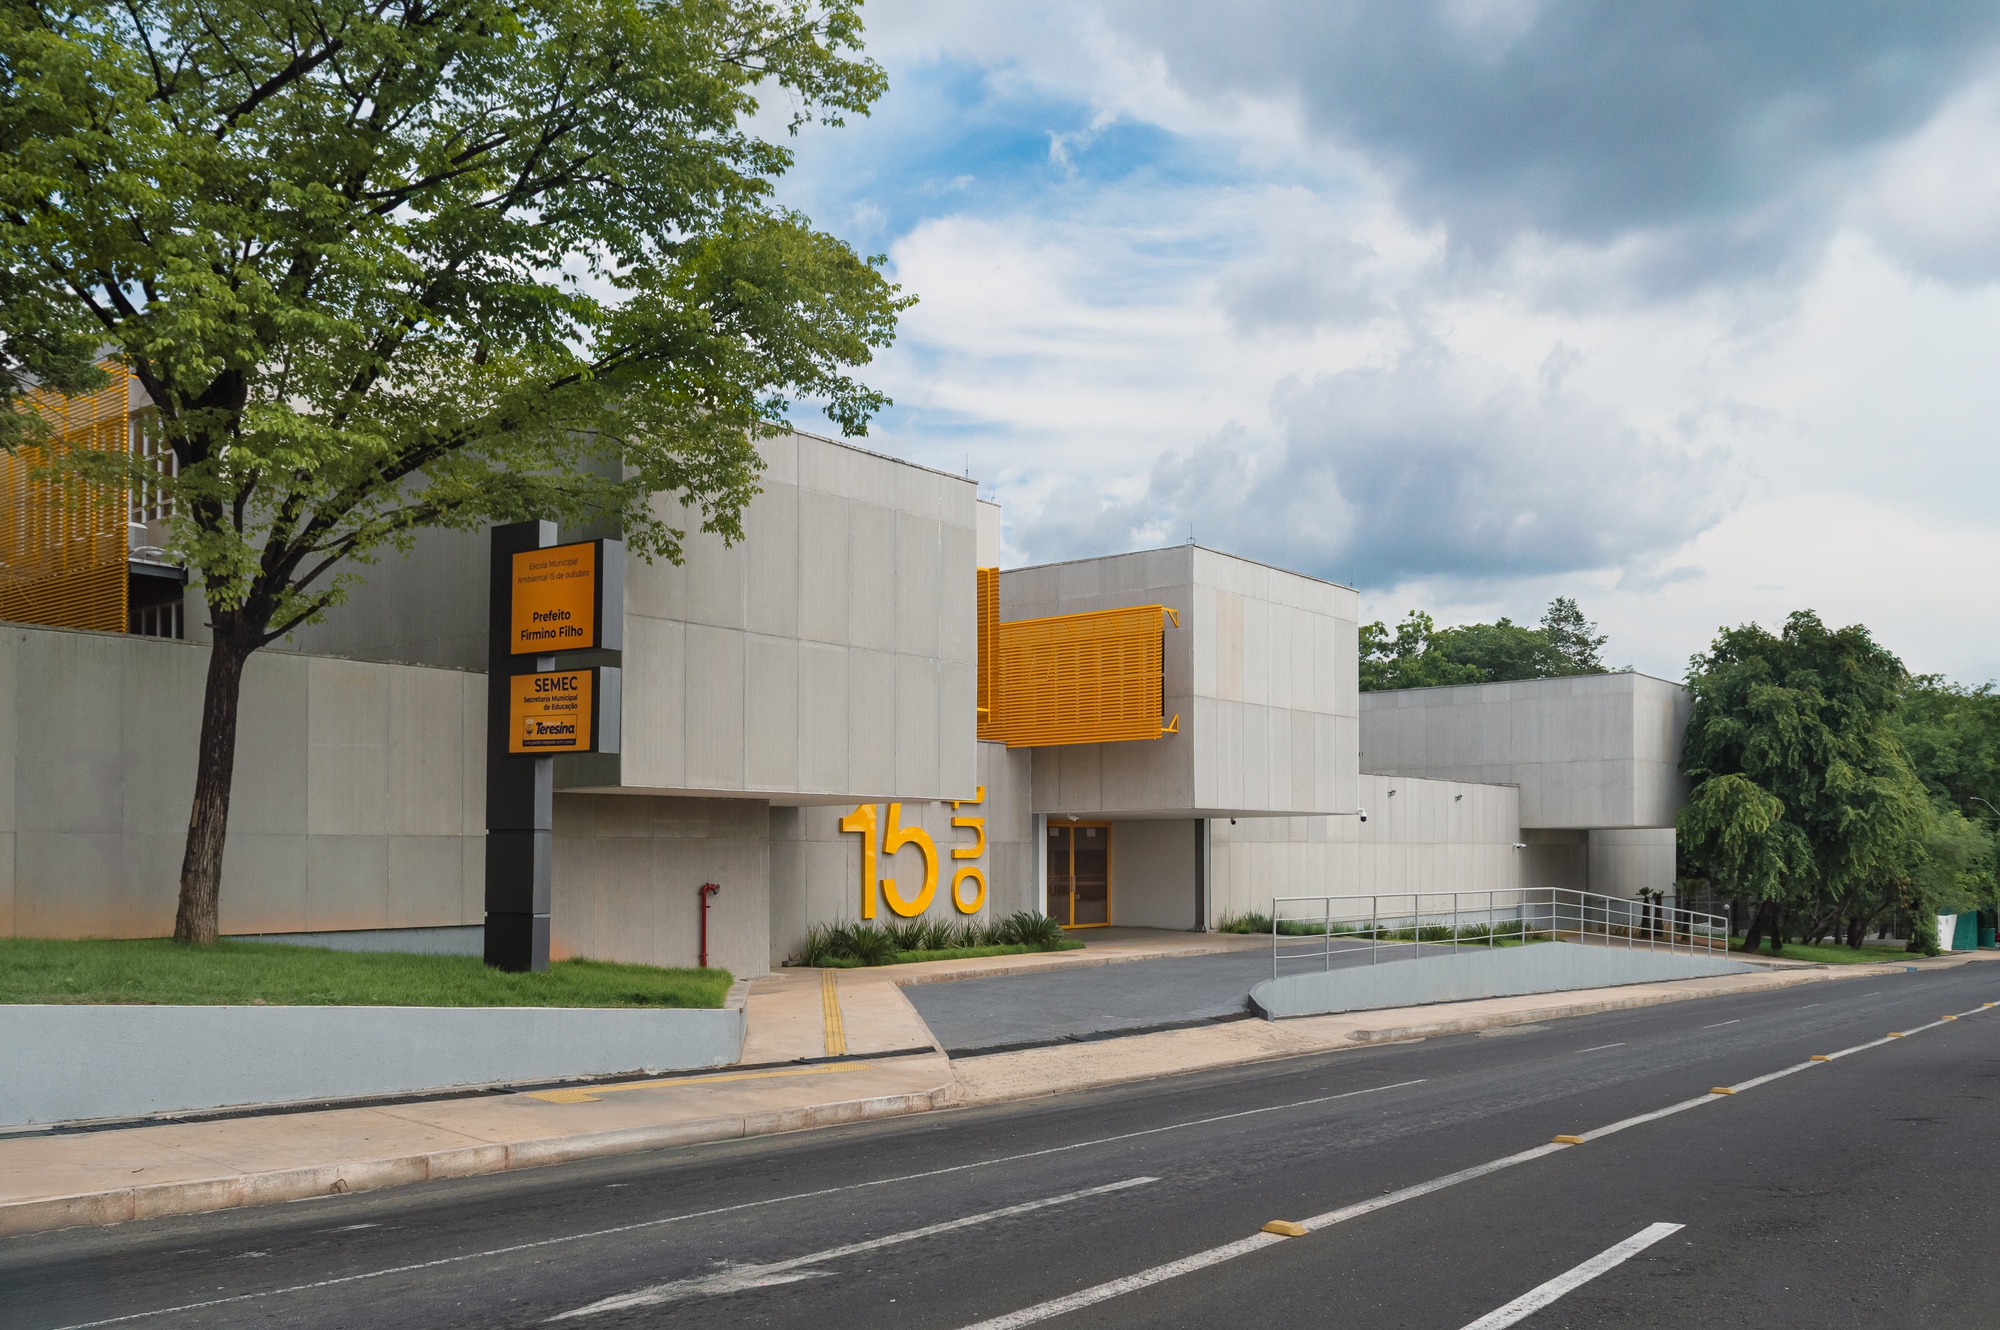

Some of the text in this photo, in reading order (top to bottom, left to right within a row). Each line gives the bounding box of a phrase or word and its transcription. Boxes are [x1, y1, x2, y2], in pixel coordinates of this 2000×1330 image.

[529, 557, 578, 571] Escola Municipal
[517, 569, 590, 584] Ambiental 15 de outubro
[533, 609, 571, 622] Prefeito
[521, 625, 583, 641] Firmino Filho
[534, 676, 578, 692] SEMEC
[523, 694, 578, 703] Secretaria Municipal
[552, 702, 578, 711] Educação
[536, 721, 575, 735] Teresina
[839, 802, 939, 920] 15
